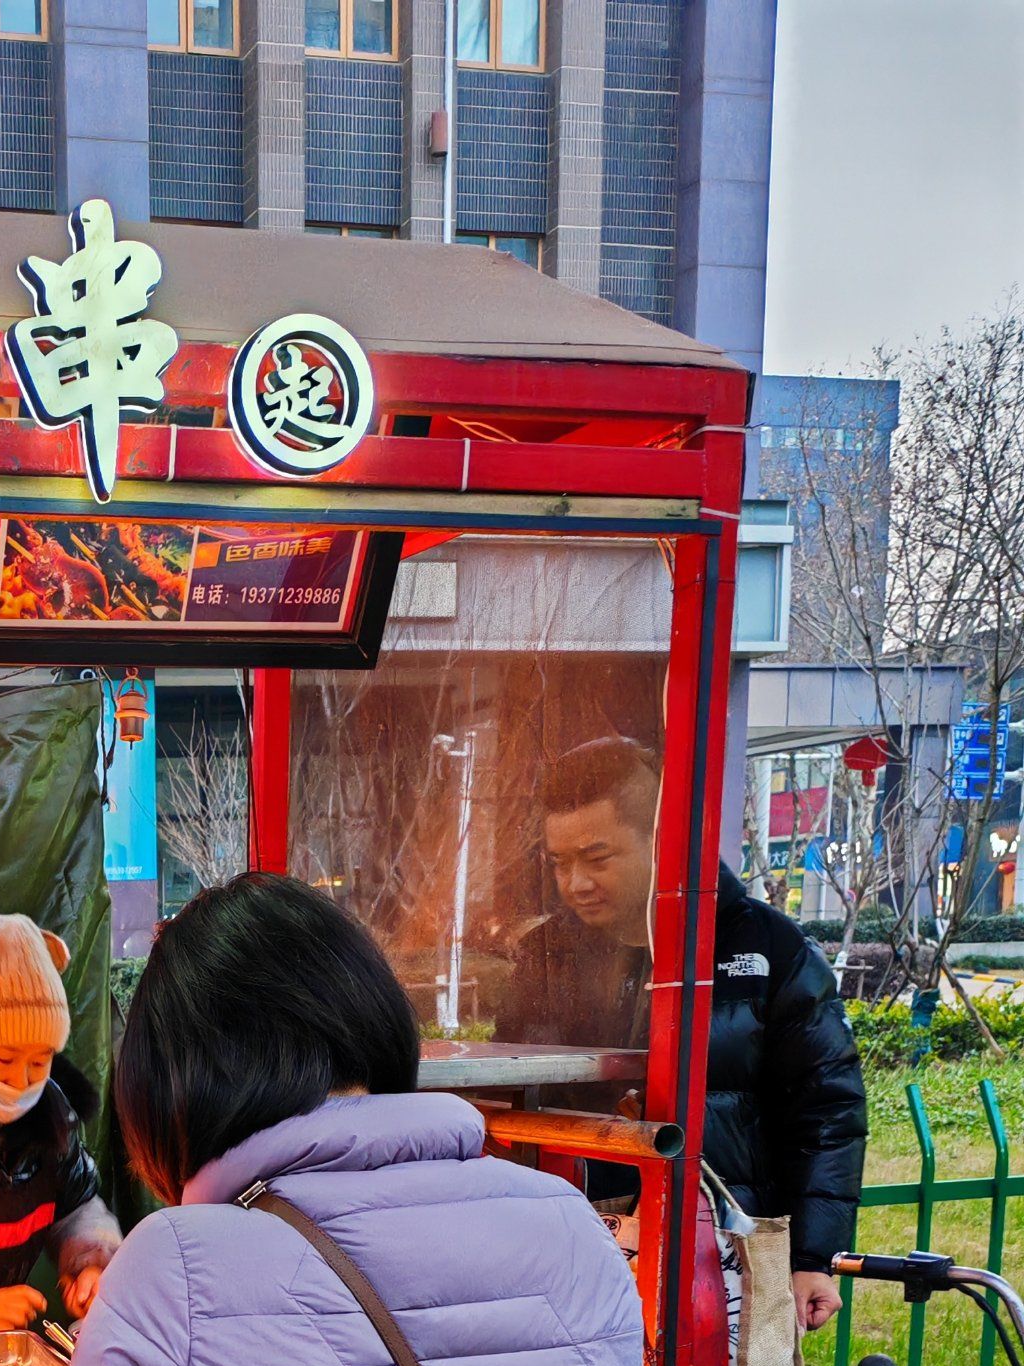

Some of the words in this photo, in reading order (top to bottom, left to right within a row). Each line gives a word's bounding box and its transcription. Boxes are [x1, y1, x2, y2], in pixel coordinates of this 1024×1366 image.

[226, 536, 333, 562] 色香味美
[240, 586, 341, 605] 19371239886
[732, 953, 754, 961] THE
[717, 961, 756, 970] NORTH
[728, 968, 757, 977] FACE
